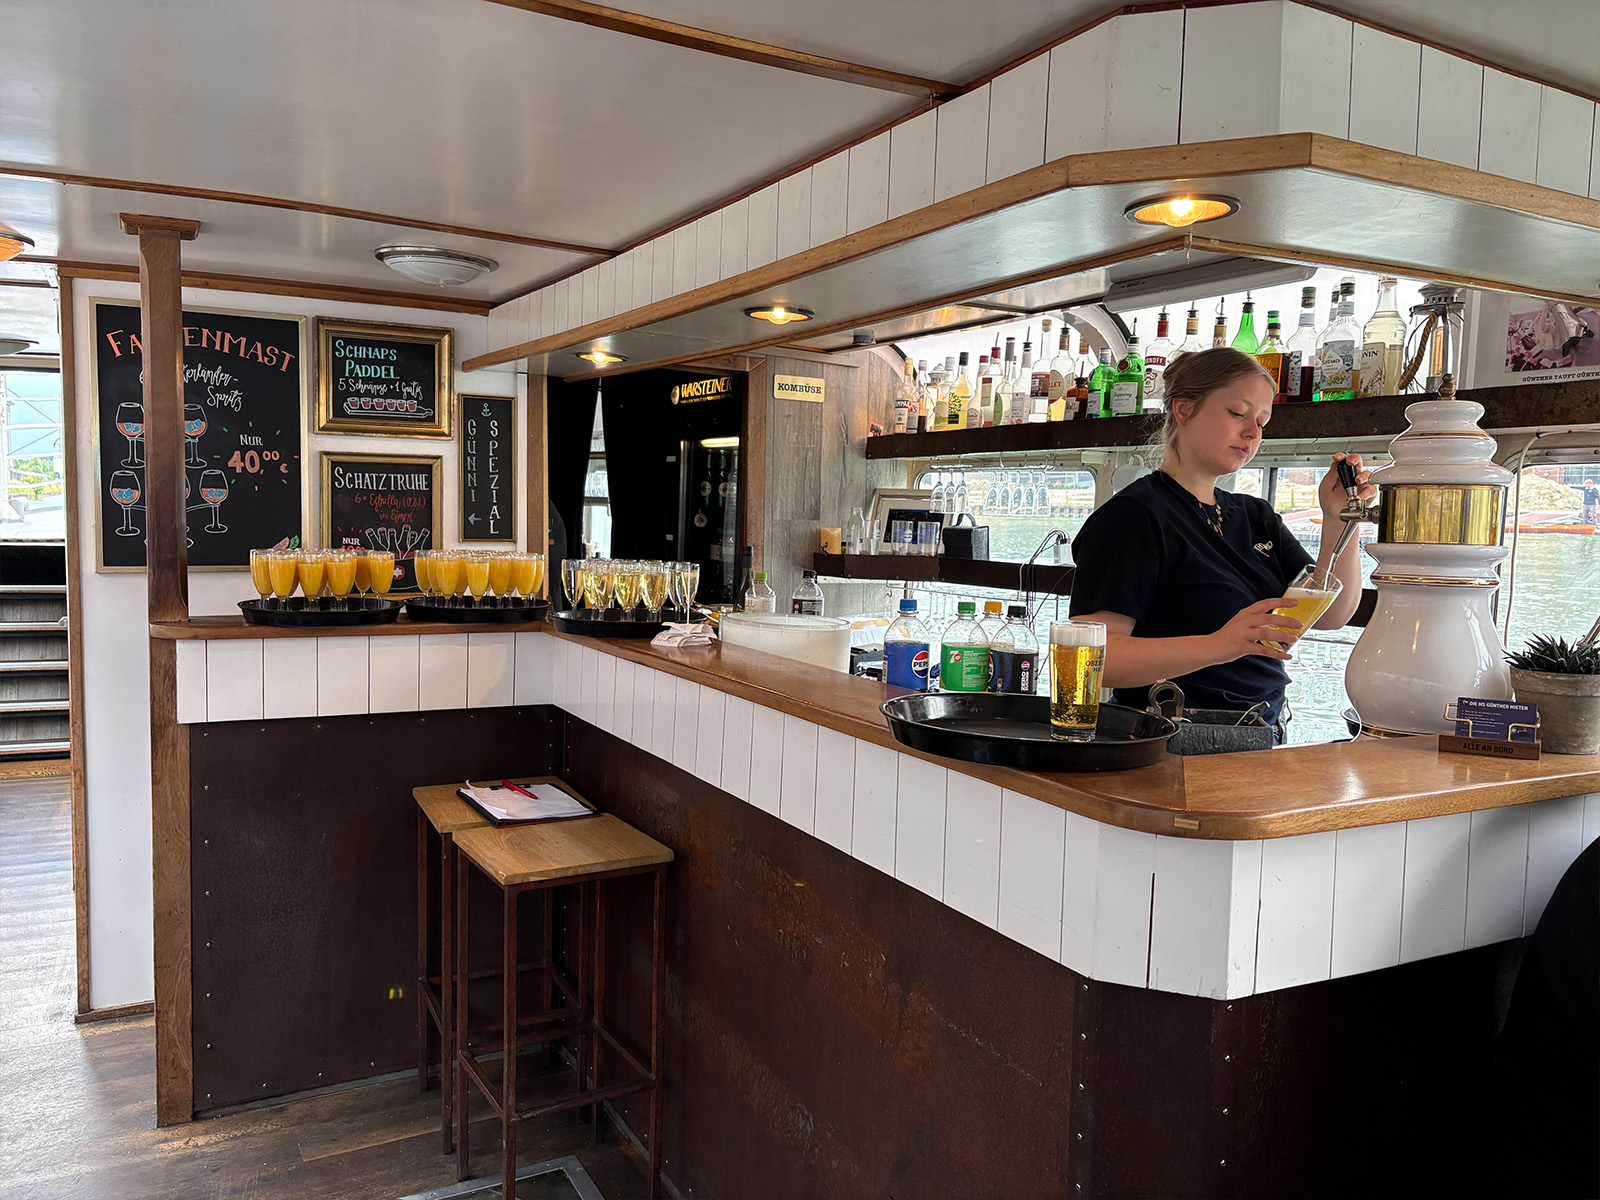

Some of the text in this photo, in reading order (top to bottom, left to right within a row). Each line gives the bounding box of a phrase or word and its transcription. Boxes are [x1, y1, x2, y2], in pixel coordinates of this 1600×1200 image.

[106, 327, 295, 373] FAENMAST
[335, 340, 398, 361] SCHNAPS
[345, 360, 400, 379] PADDEL
[338, 378, 346, 391] 5
[681, 376, 733, 398] WARSTEINER
[777, 382, 822, 394] KOMBÜSE
[467, 419, 477, 502] GÜNNI
[334, 466, 430, 490] SCHATZTRUHE
[489, 420, 501, 534] SPEZIAL
[1463, 743, 1480, 751] ALLE
